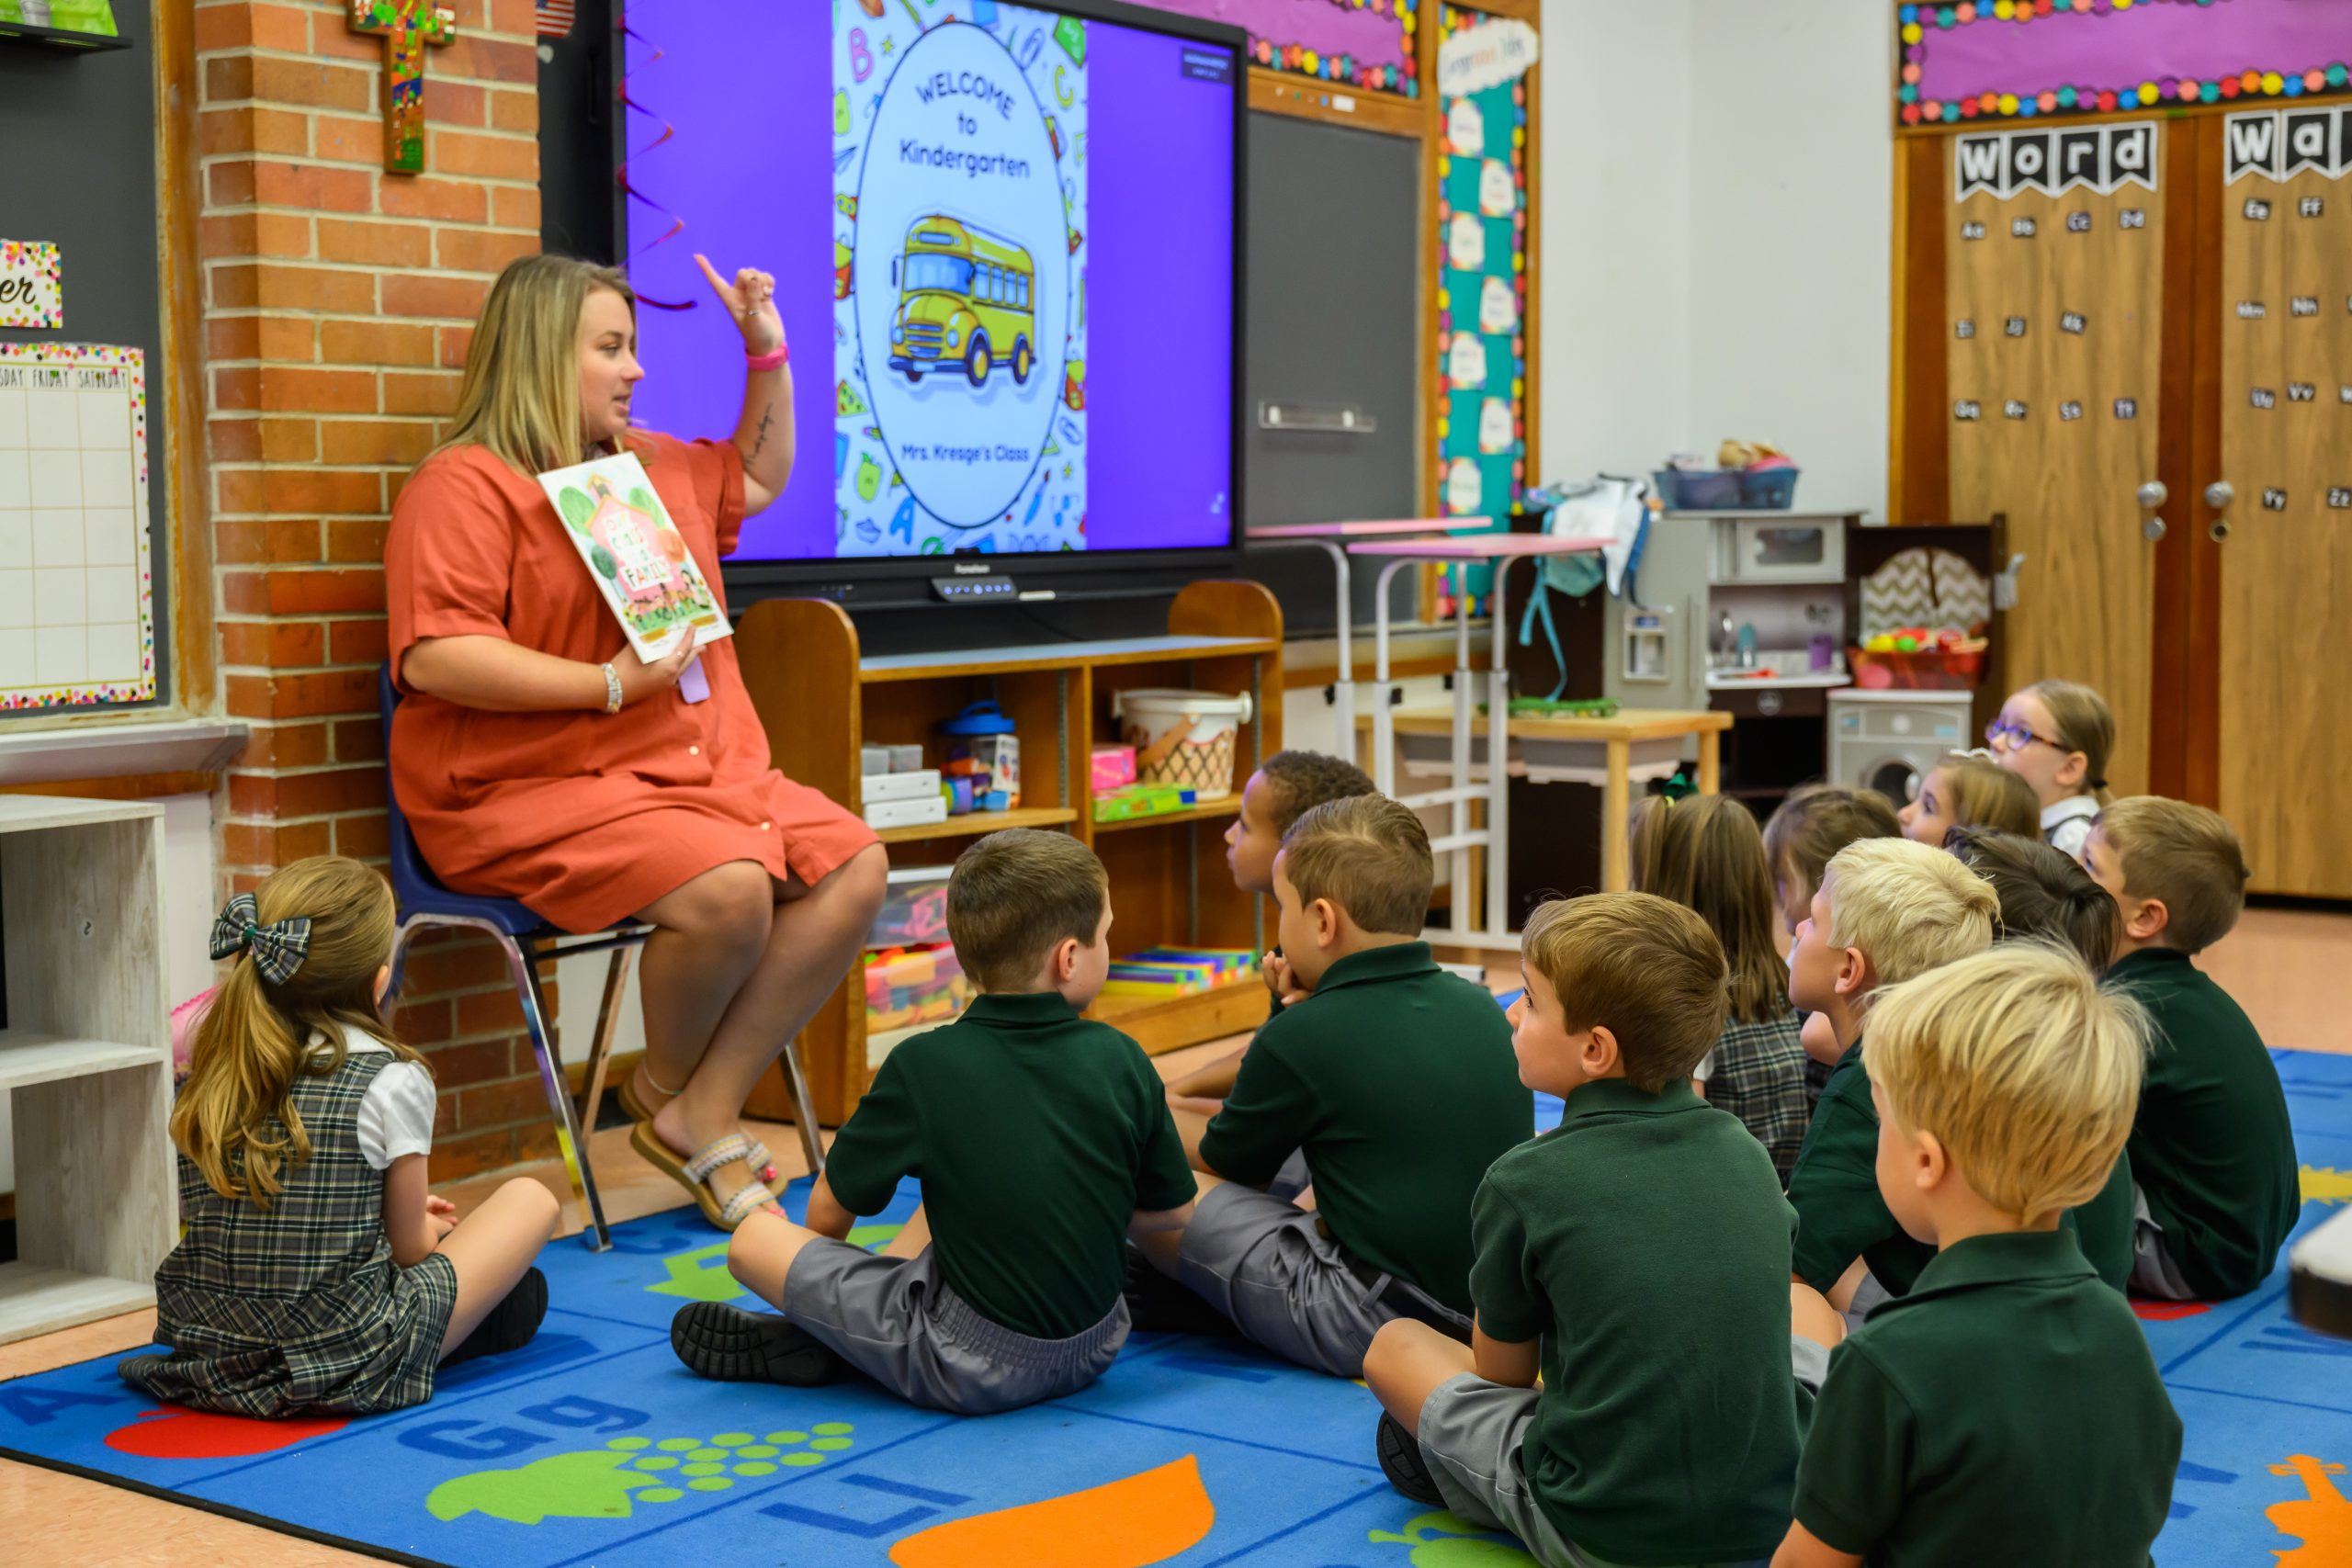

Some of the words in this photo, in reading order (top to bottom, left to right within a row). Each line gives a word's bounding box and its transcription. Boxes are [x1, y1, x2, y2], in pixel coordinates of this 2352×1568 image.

[915, 71, 1015, 121] WELCOME
[957, 111, 978, 136] to
[899, 139, 1030, 179] Kindergarten
[1962, 129, 2145, 181] Word
[33, 369, 69, 388] FRIDAY
[78, 370, 127, 389] SATURDAY
[902, 445, 928, 460] Mrs.
[933, 444, 991, 466] Kresge's
[994, 445, 1029, 461] Class
